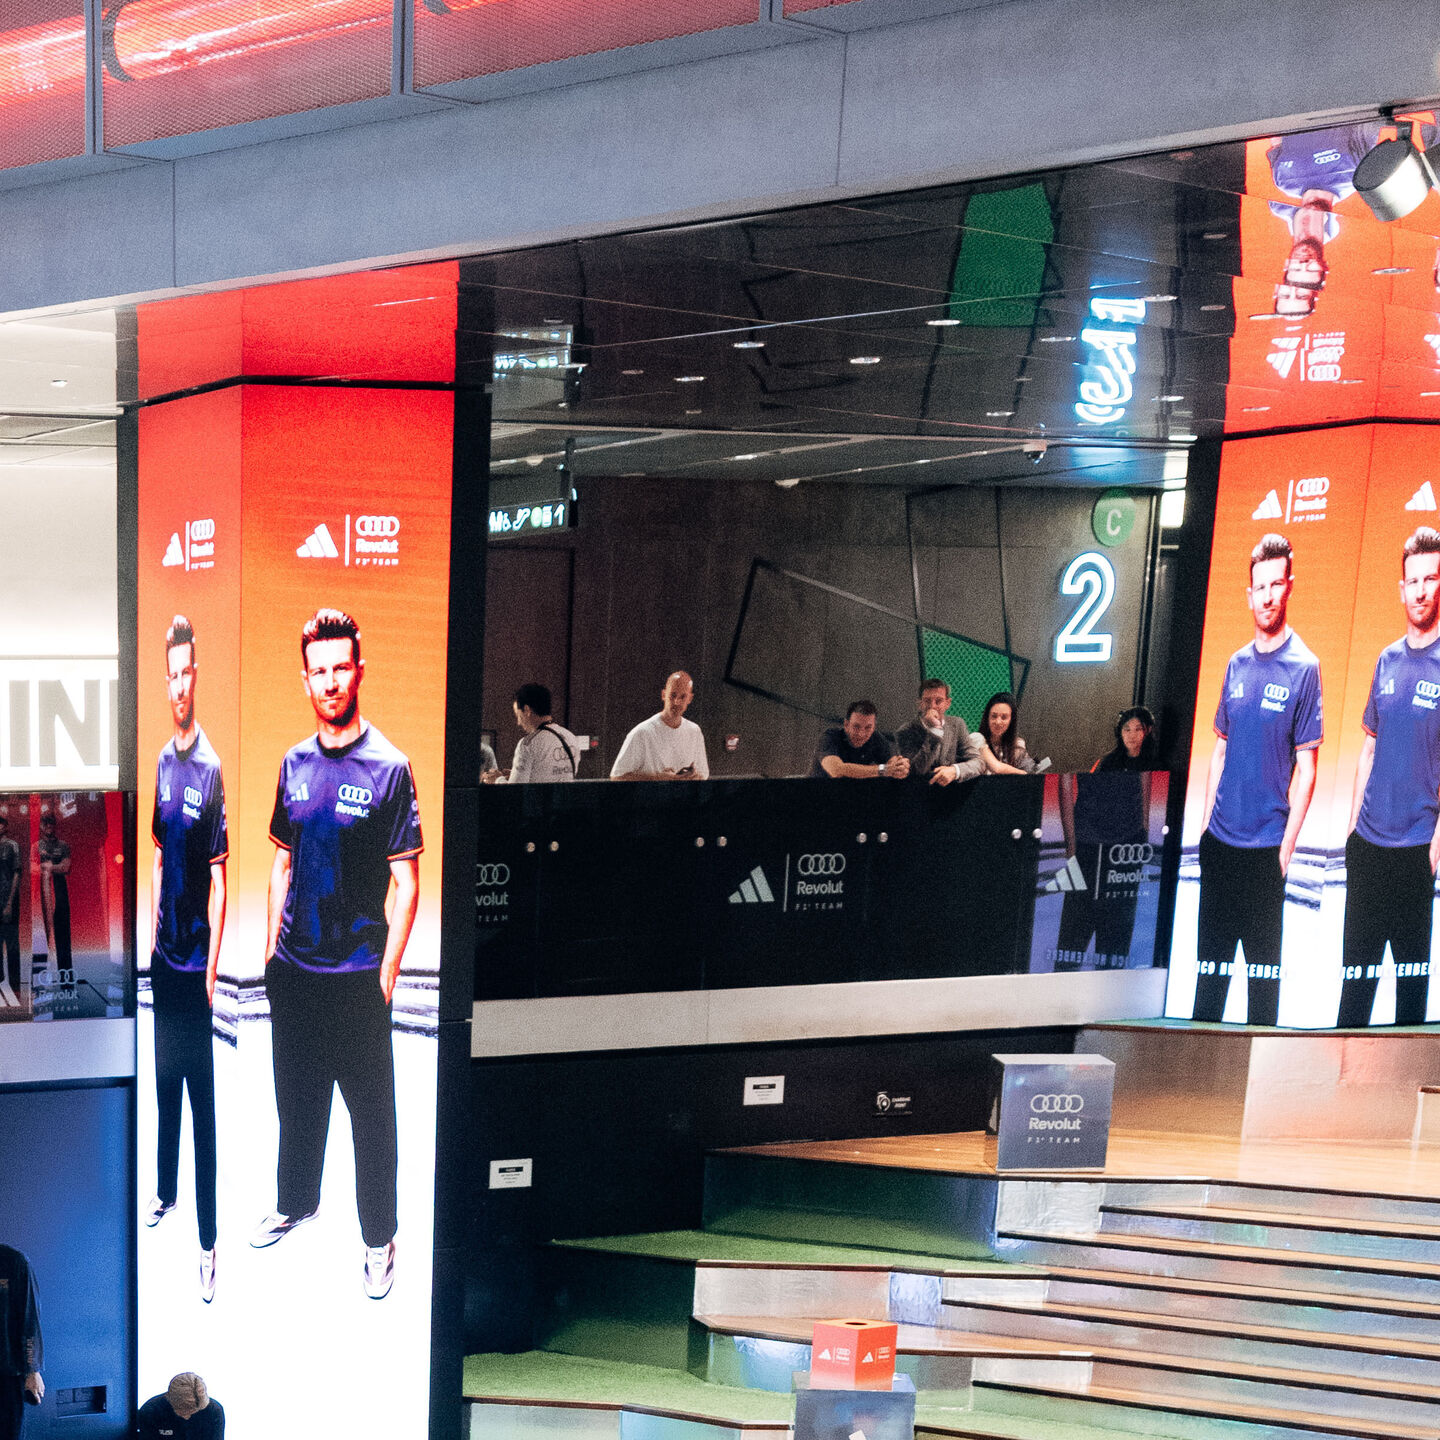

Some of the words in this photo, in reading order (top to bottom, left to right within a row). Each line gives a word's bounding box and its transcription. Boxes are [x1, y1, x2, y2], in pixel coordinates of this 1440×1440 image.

[1056, 551, 1116, 662] 2
[1107, 868, 1151, 885] Revolut
[796, 880, 844, 895] Revolut
[475, 891, 509, 906] volut
[815, 901, 843, 910] TEAM
[1028, 1117, 1082, 1130] Revolut
[1048, 1136, 1081, 1144] TEAM
